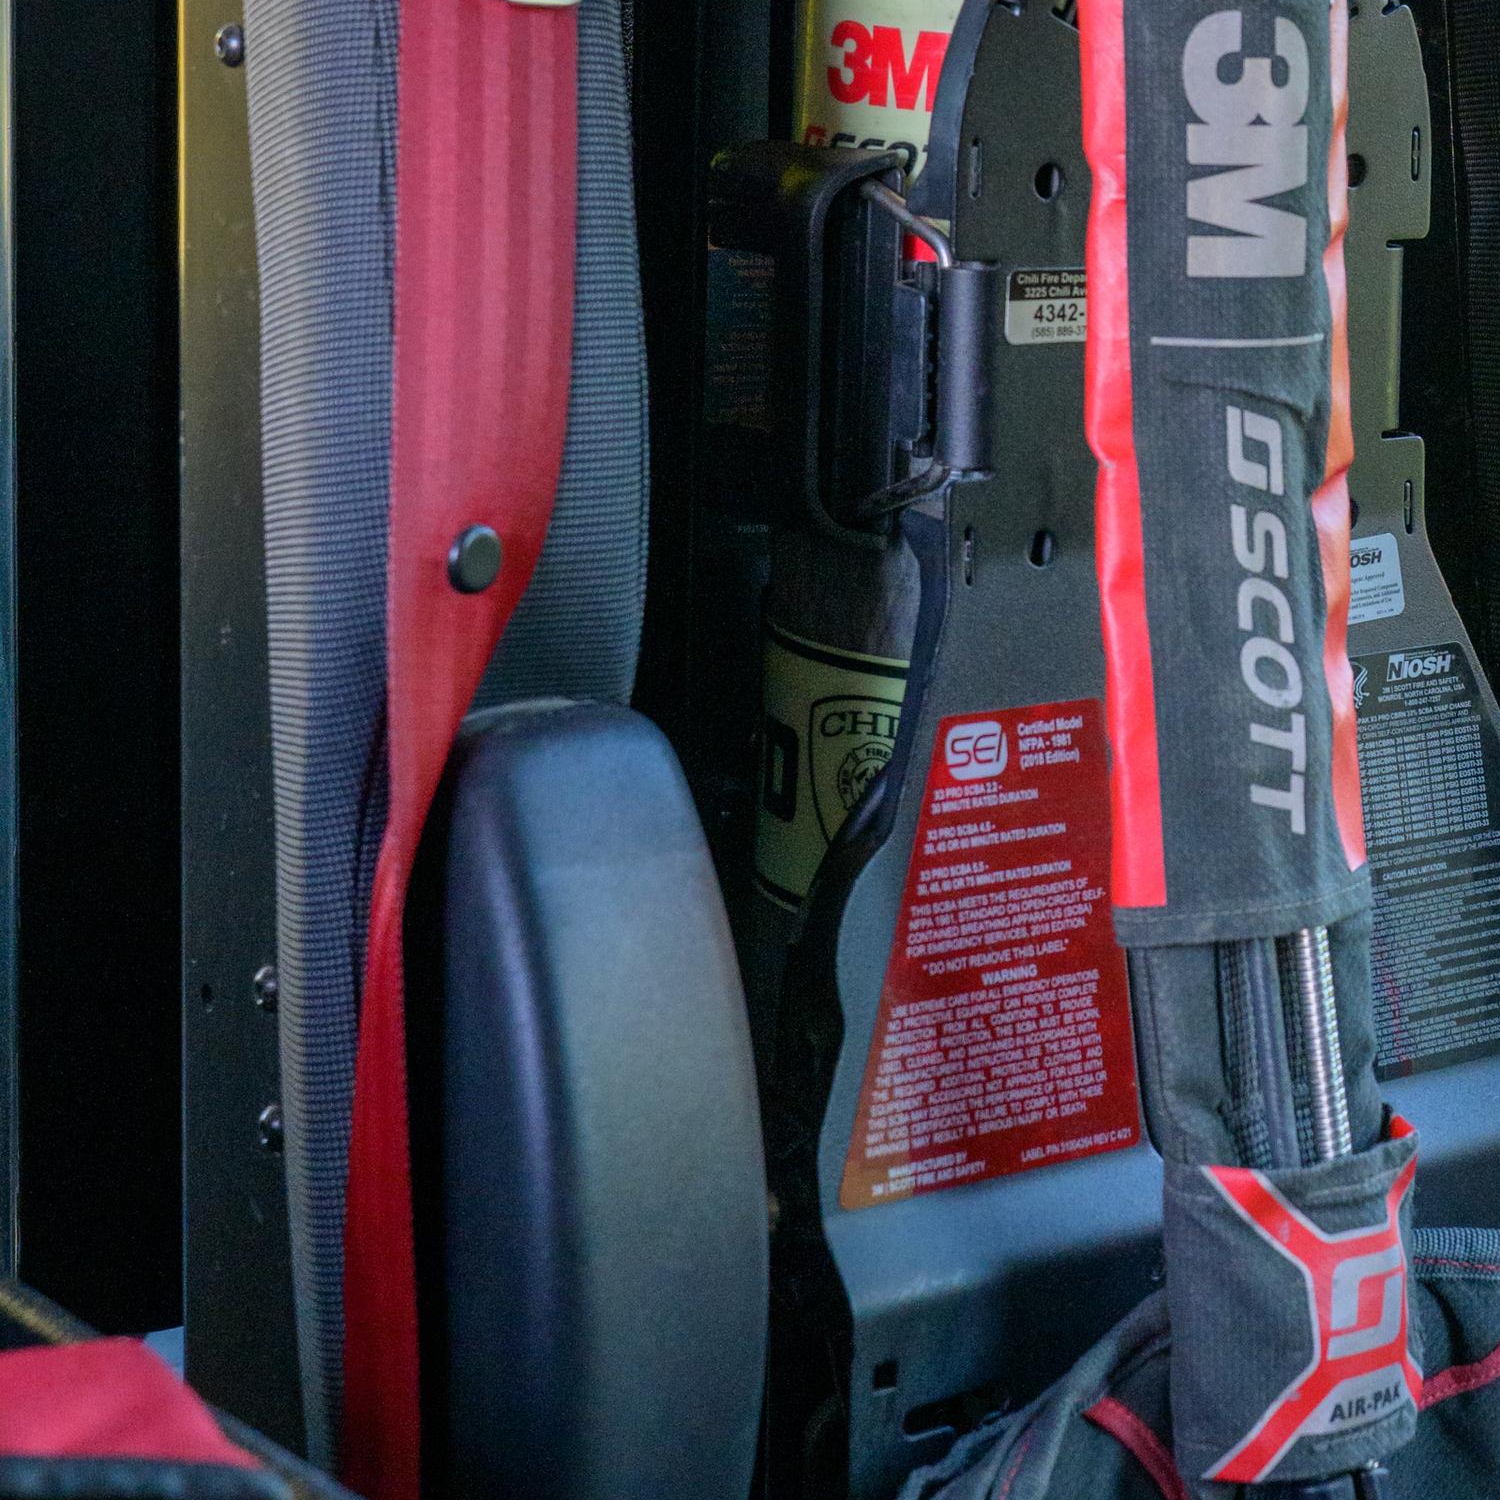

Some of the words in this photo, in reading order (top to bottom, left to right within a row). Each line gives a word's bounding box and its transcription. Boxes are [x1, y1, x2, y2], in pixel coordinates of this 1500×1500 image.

[827, 19, 950, 113] 3M
[1181, 8, 1310, 279] 3M
[1017, 273, 1039, 284] Chili
[1041, 273, 1059, 284] Fire
[1060, 272, 1086, 285] Depa
[1034, 303, 1085, 322] 4342-
[1350, 550, 1382, 568] OSH
[1231, 506, 1307, 837] SCOTT
[1387, 657, 1451, 681] NIOSH
[821, 710, 900, 740] CHI
[1018, 718, 1054, 736] Certified
[1055, 714, 1083, 731] Model
[949, 732, 1004, 769] SEI
[981, 962, 1036, 987] WARNING
[1329, 1382, 1400, 1422] AIR-PAK
